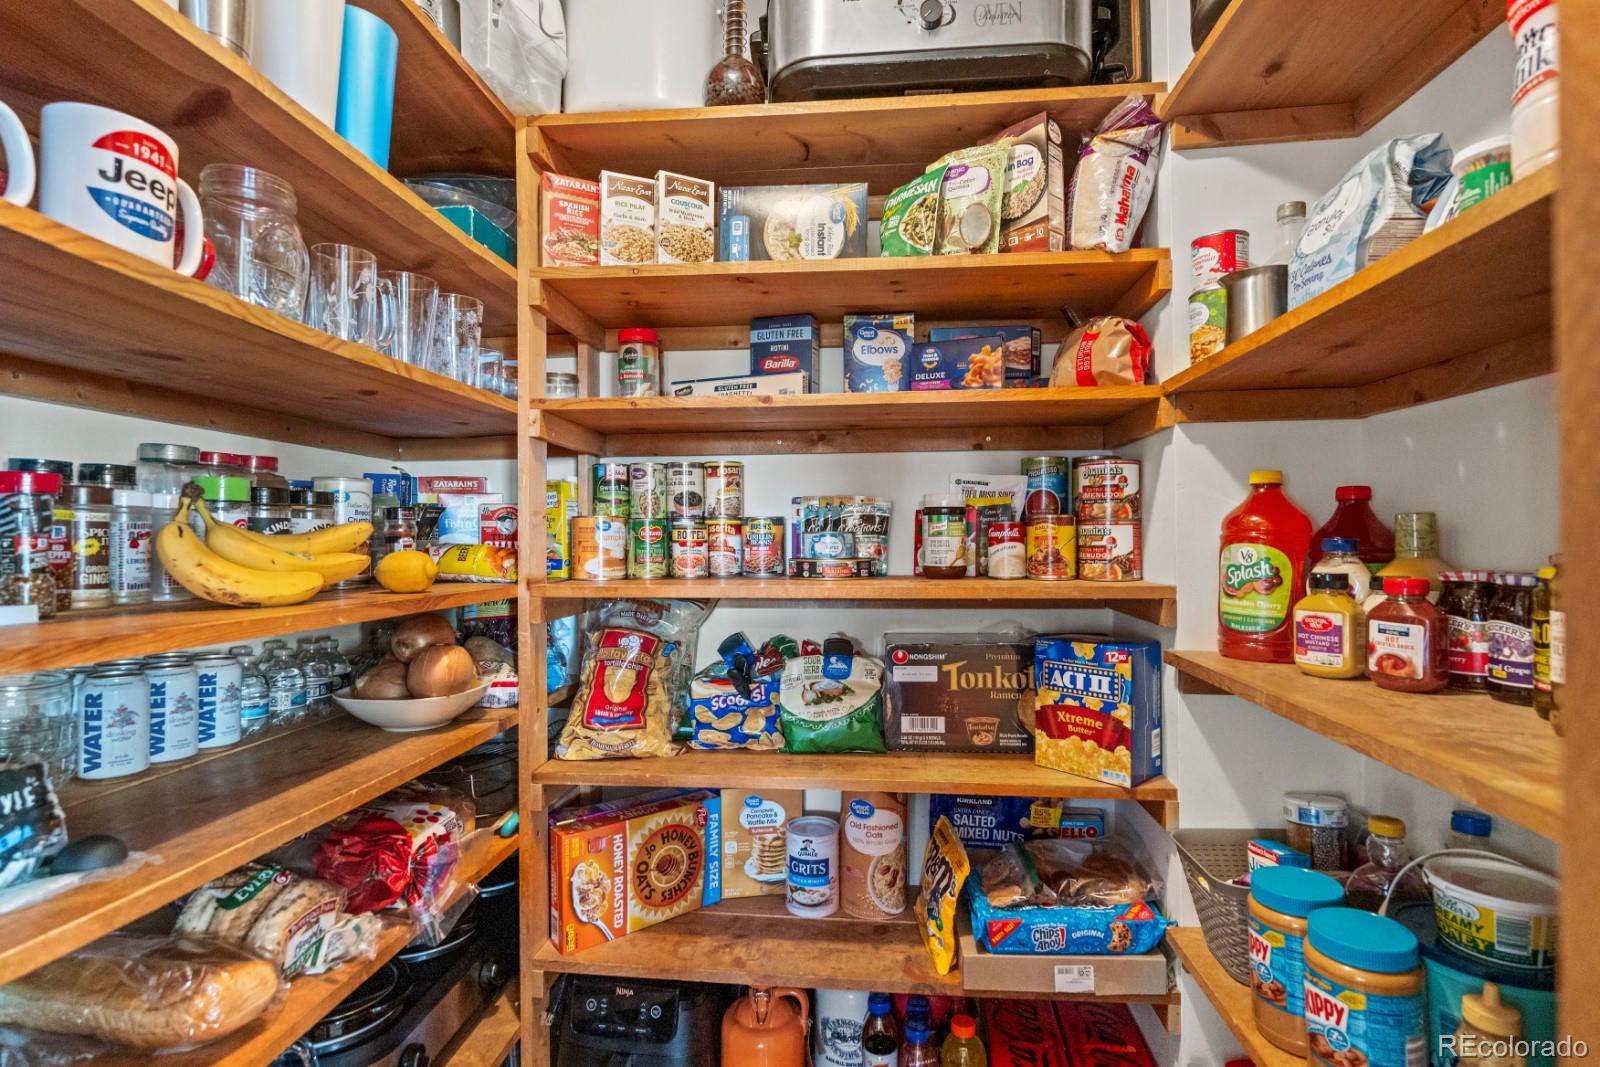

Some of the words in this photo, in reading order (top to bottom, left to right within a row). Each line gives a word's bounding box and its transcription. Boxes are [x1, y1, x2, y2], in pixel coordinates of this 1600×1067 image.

[974, 1, 1023, 27] OVEN
[133, 142, 165, 168] 1941
[1016, 156, 1034, 169] Bag
[98, 157, 175, 211] Jeep
[553, 177, 599, 194] ZATARAIN'
[610, 180, 635, 193] Near
[635, 185, 652, 196] East
[668, 180, 688, 193] Near
[688, 185, 707, 196] East
[887, 178, 938, 210] PARMESAN
[1115, 164, 1137, 226] Mahatma
[559, 200, 590, 212] SPANISH
[670, 199, 703, 211] COUSCOUS
[566, 208, 584, 217] RICE
[817, 223, 826, 256] Instant
[757, 331, 784, 340] GLUTEN
[786, 329, 804, 338] FREE
[770, 344, 789, 352] ROTINI
[860, 345, 899, 355] Elbows
[764, 359, 797, 369] Barilla
[916, 372, 946, 380] DELUXE
[433, 480, 479, 489] ZATARAIN'S
[978, 490, 996, 499] MISO
[1083, 491, 1120, 500] MENUDO
[82, 528, 109, 538] SPIC
[709, 525, 736, 536] sarita
[988, 528, 1020, 538] Campbell's
[1240, 549, 1254, 564] V8
[81, 574, 109, 585] GING
[1227, 560, 1271, 588] Splash
[1298, 632, 1309, 640] HOT
[1310, 634, 1340, 642] CHINESE
[1304, 640, 1330, 648] MUSTARD
[1398, 643, 1416, 651] SAUCE
[803, 657, 824, 665] SOUR
[986, 653, 1021, 661] Premium
[1106, 652, 1118, 662] 12
[803, 666, 820, 674] HERB
[942, 660, 1036, 691] Tonkot
[1504, 665, 1532, 676] Grape
[1050, 670, 1086, 690] ACT
[1088, 674, 1112, 694] II
[711, 685, 765, 711] SCOOS!
[990, 690, 1022, 700] Ramen
[198, 672, 217, 744] WATER
[150, 681, 166, 757] WATER
[1057, 711, 1104, 730] Xtreme
[83, 692, 103, 774] WATER
[1068, 724, 1093, 736] Butter
[956, 797, 993, 805] KIRKLAND
[850, 822, 862, 830] Old
[862, 822, 899, 831] Fashioned
[953, 814, 996, 828] SALTED
[660, 829, 698, 850] HONEY
[708, 813, 719, 858] FAMILY
[954, 826, 990, 841] MIXED
[992, 829, 1025, 844] NUTS
[613, 834, 624, 876] HONEY
[798, 850, 818, 858] QUAKER
[708, 862, 719, 888] SIZE
[791, 860, 826, 876] GRITS
[636, 861, 656, 900] OATS
[660, 849, 702, 902] BUNCHES
[613, 877, 624, 929] ROASTED
[1436, 905, 1485, 933] REAMY
[1032, 926, 1060, 943] Chips
[1072, 929, 1105, 940] ORIGINAL
[1440, 922, 1490, 951] ONEY
[616, 986, 634, 996] Ninja
[1306, 985, 1345, 1027] KIPPY
